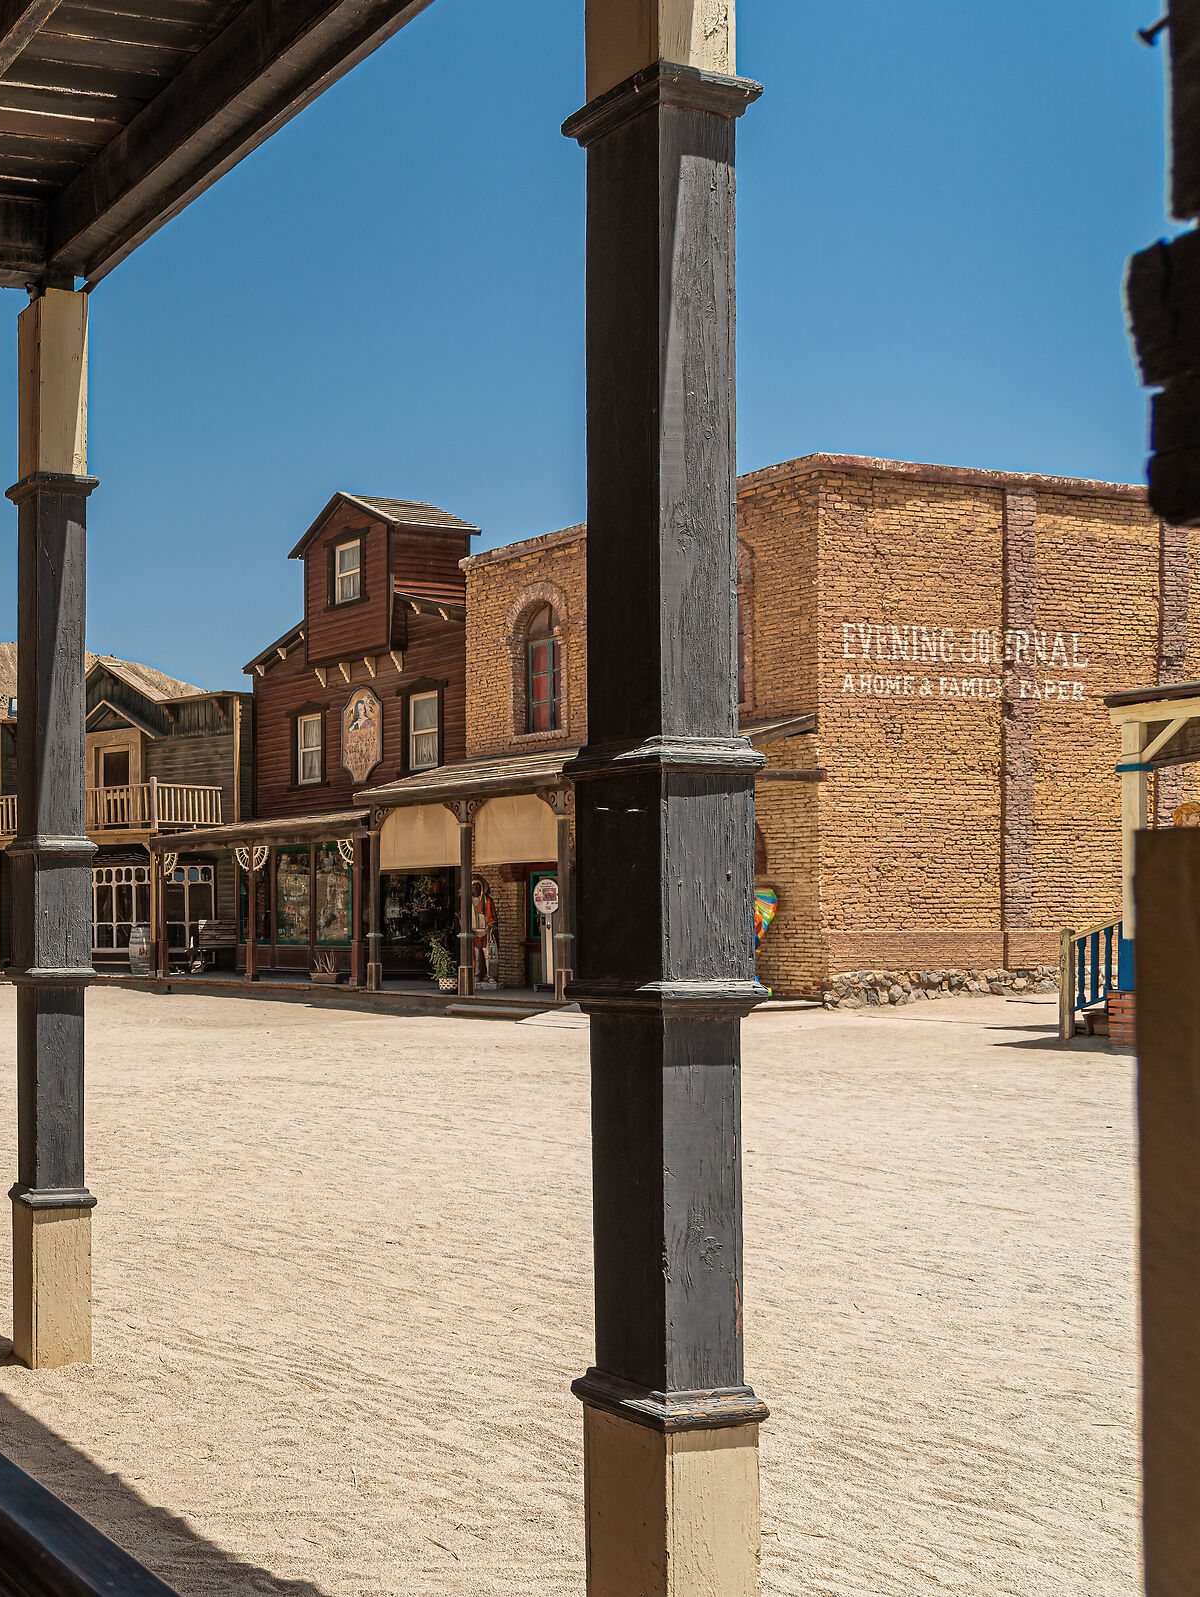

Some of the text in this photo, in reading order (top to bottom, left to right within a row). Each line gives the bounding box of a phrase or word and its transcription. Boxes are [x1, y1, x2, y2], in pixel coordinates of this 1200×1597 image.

[841, 623, 1089, 668] EVENING JOURNAL
[840, 673, 1086, 701] A HOME & FAMILY PAPER
